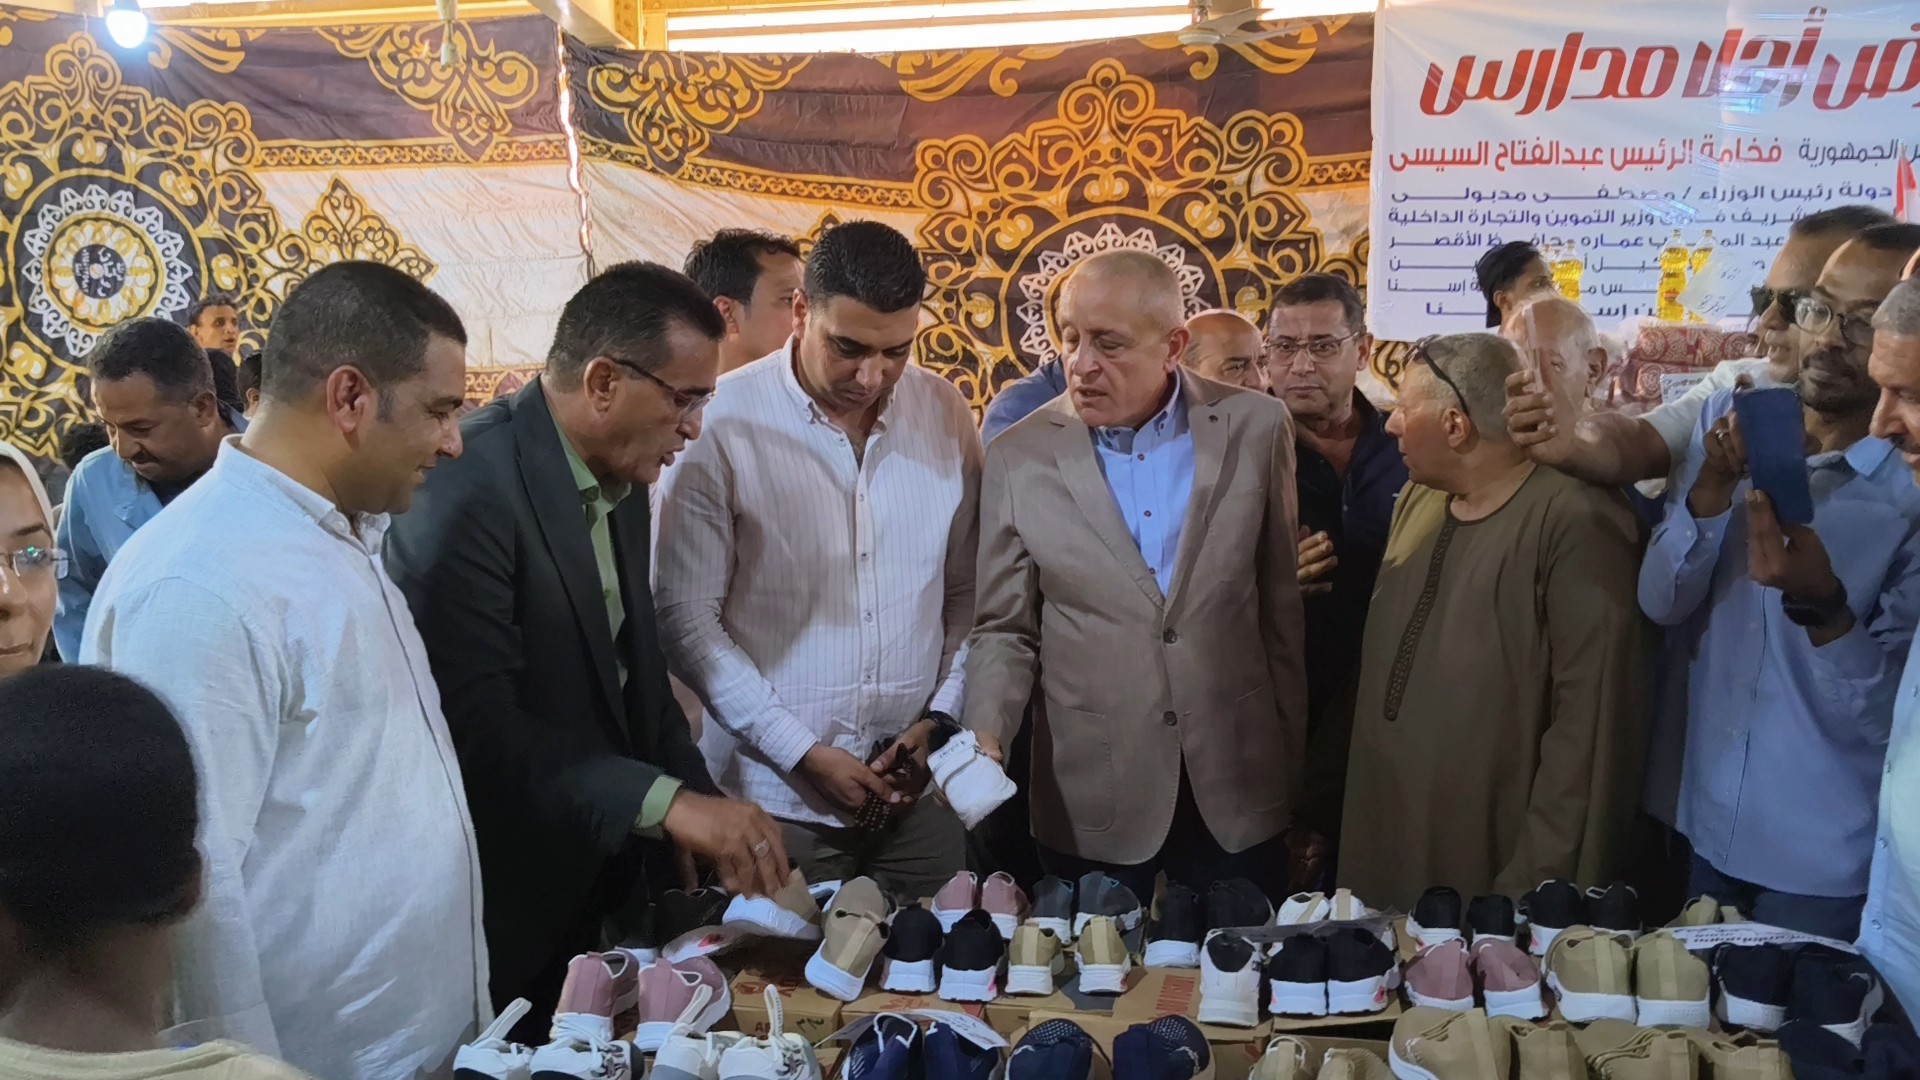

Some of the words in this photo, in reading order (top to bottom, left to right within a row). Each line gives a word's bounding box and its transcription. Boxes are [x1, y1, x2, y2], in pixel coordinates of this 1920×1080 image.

[1420, 31, 1679, 115] مدارس
[1610, 138, 1693, 171] الرئيس
[1700, 134, 1782, 164] فخامة
[1798, 138, 1898, 167] الجمهورية
[1699, 185, 1765, 201] الوزراء
[1771, 184, 1832, 201] رئيس
[1838, 181, 1893, 199] دولة
[1388, 207, 1464, 226] الداخلية
[1468, 209, 1540, 226] والتجارة
[1545, 209, 1615, 226] التموين
[1619, 210, 1654, 226] وزير
[1388, 229, 1482, 249] الأقصر
[1750, 234, 1786, 248] عبد
